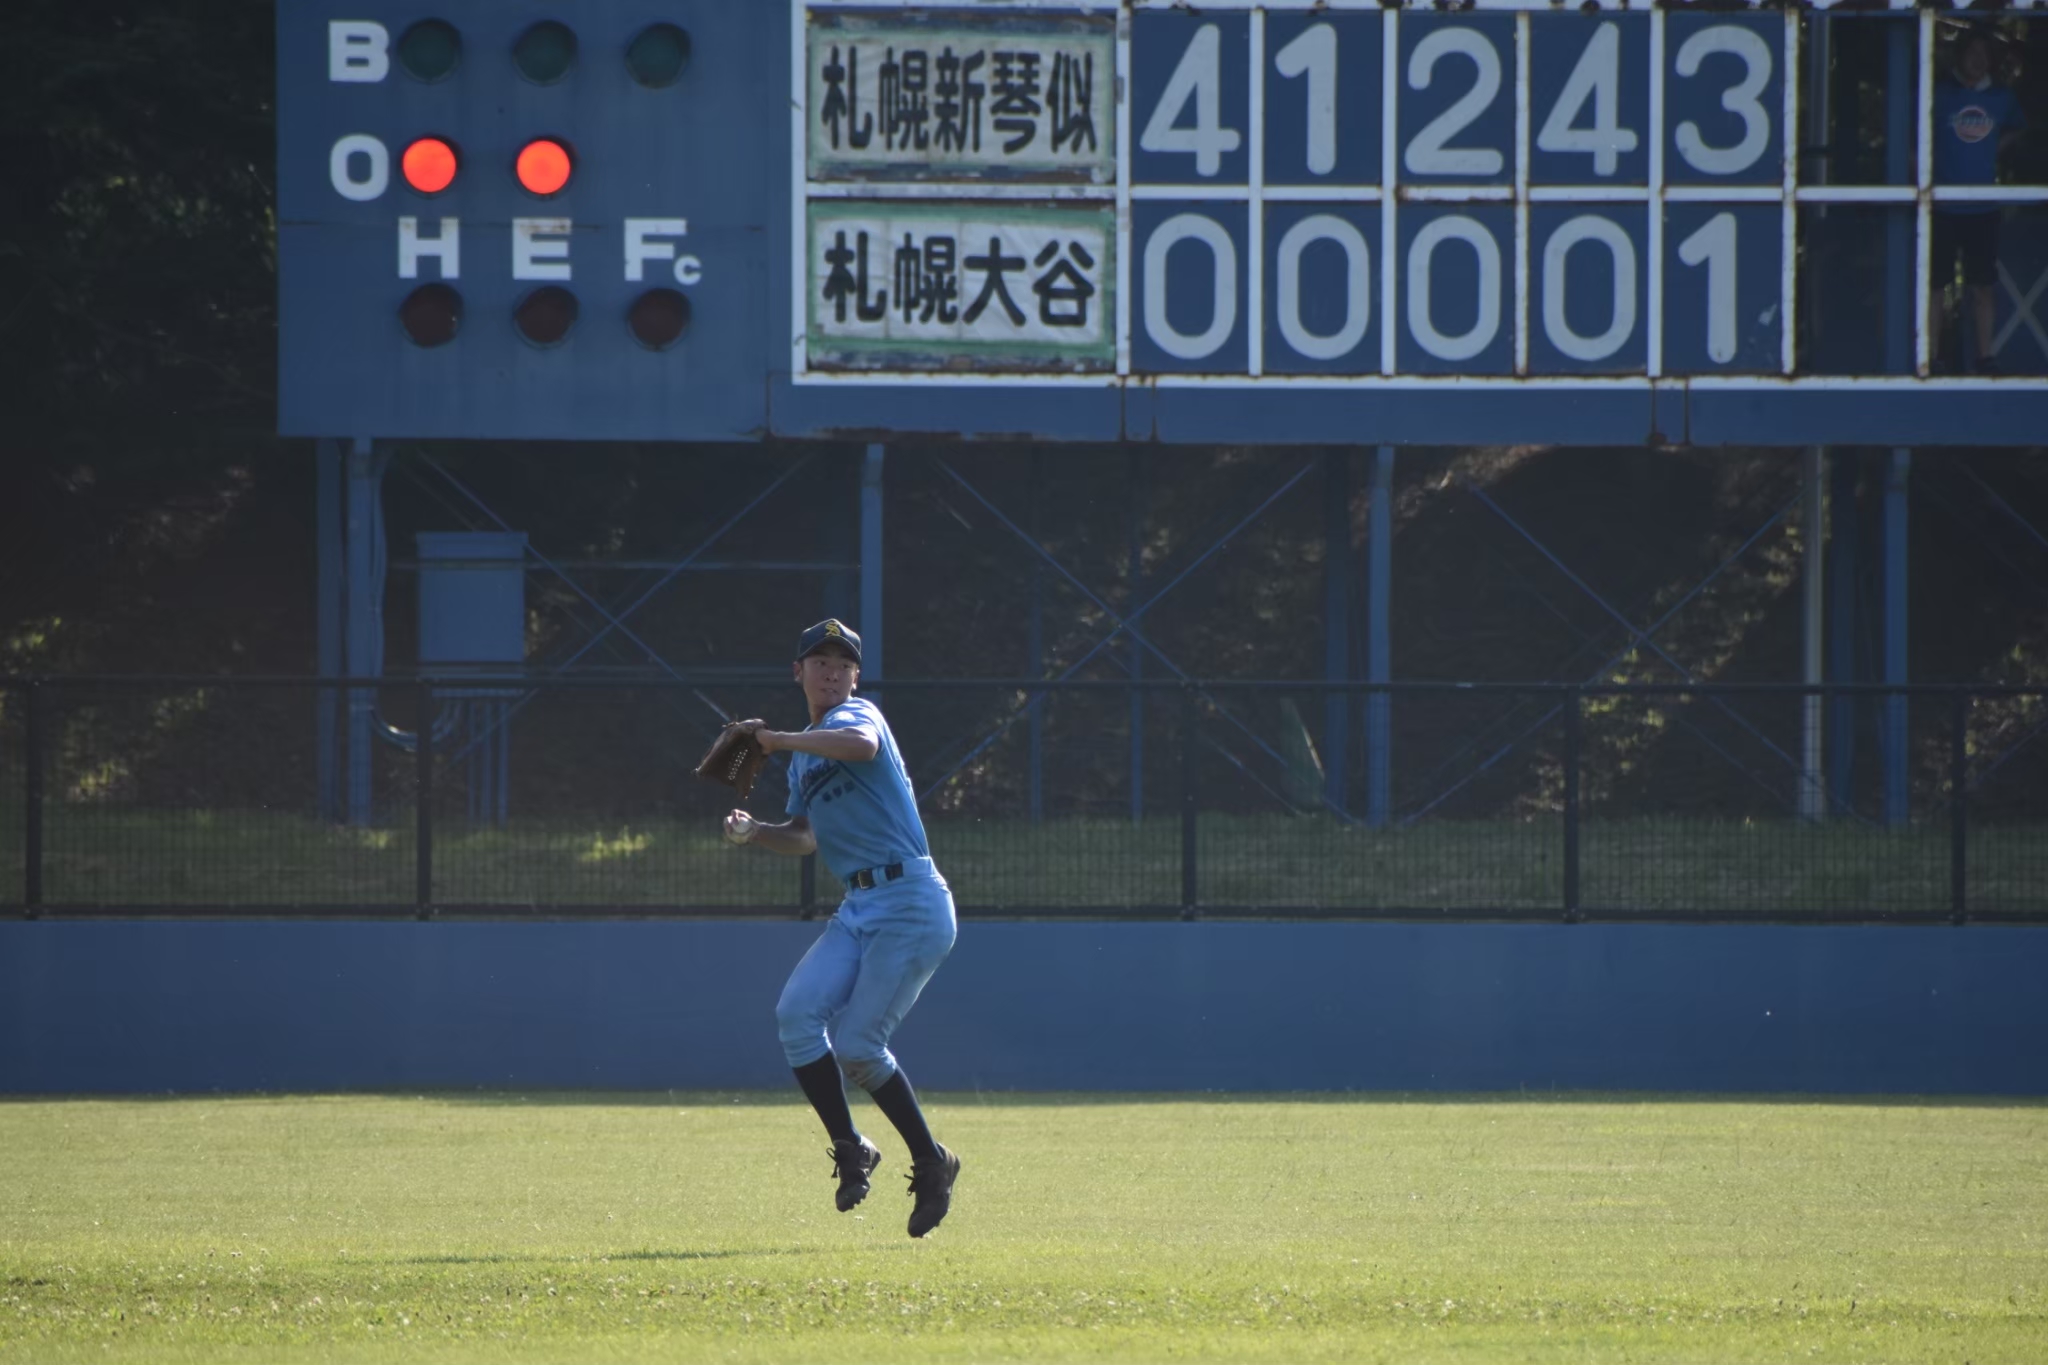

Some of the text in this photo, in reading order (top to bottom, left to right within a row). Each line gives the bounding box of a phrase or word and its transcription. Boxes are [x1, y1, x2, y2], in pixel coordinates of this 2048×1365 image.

[328, 19, 390, 83] B
[821, 46, 1098, 153] 札幌新琴似
[1140, 22, 1772, 177] 4 1 2 4 3
[330, 134, 391, 201] O
[397, 217, 460, 279] H
[512, 218, 572, 281] E
[823, 230, 1095, 327] 札幌大谷
[1143, 212, 1738, 364] 0 0 0 0 1
